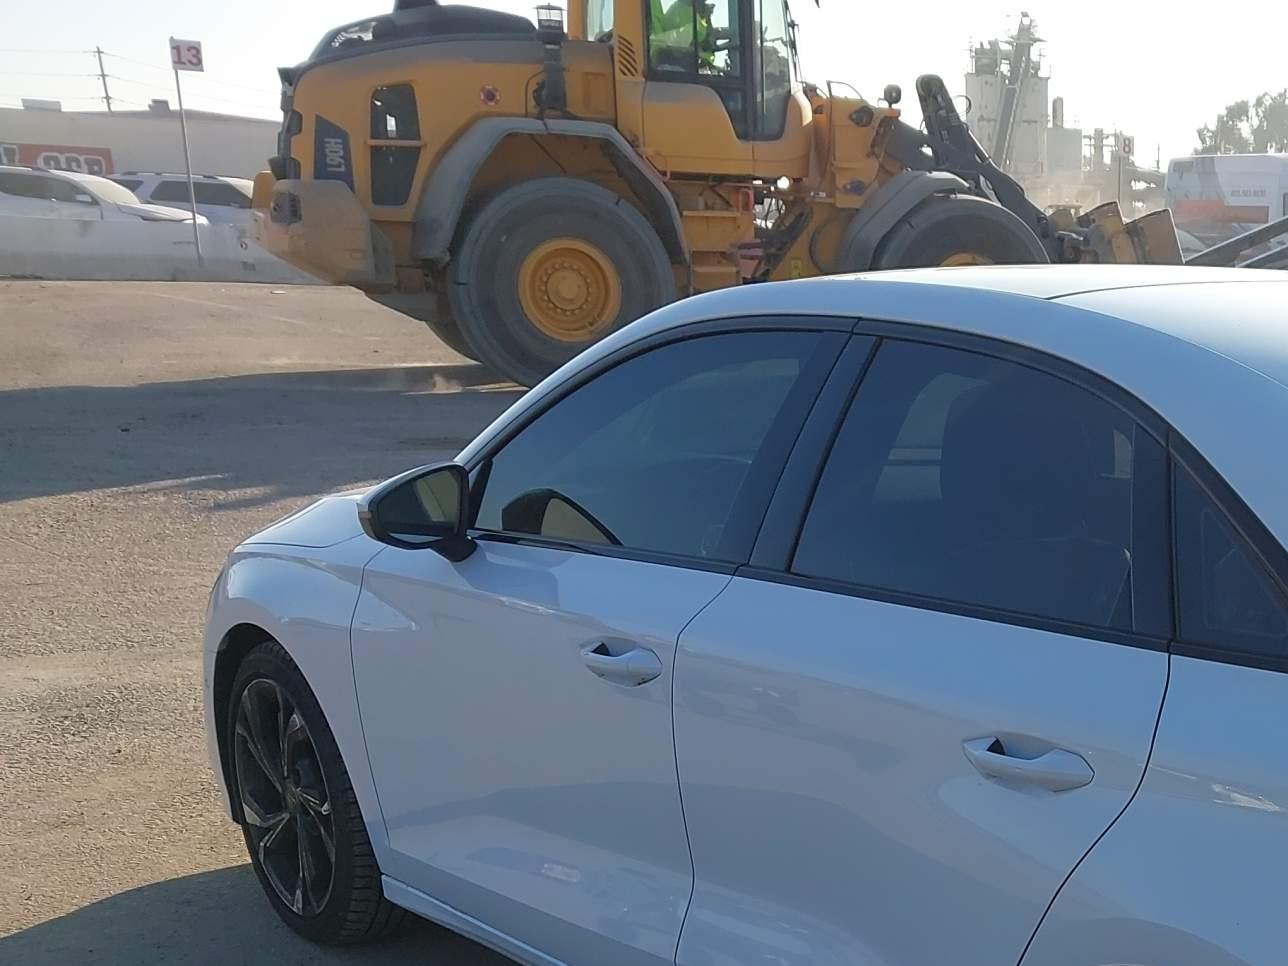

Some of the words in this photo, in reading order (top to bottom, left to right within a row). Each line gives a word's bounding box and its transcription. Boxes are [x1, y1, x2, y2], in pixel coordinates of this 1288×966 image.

[171, 45, 202, 66] 13
[324, 138, 346, 172] L90H
[1122, 137, 1132, 154] 8
